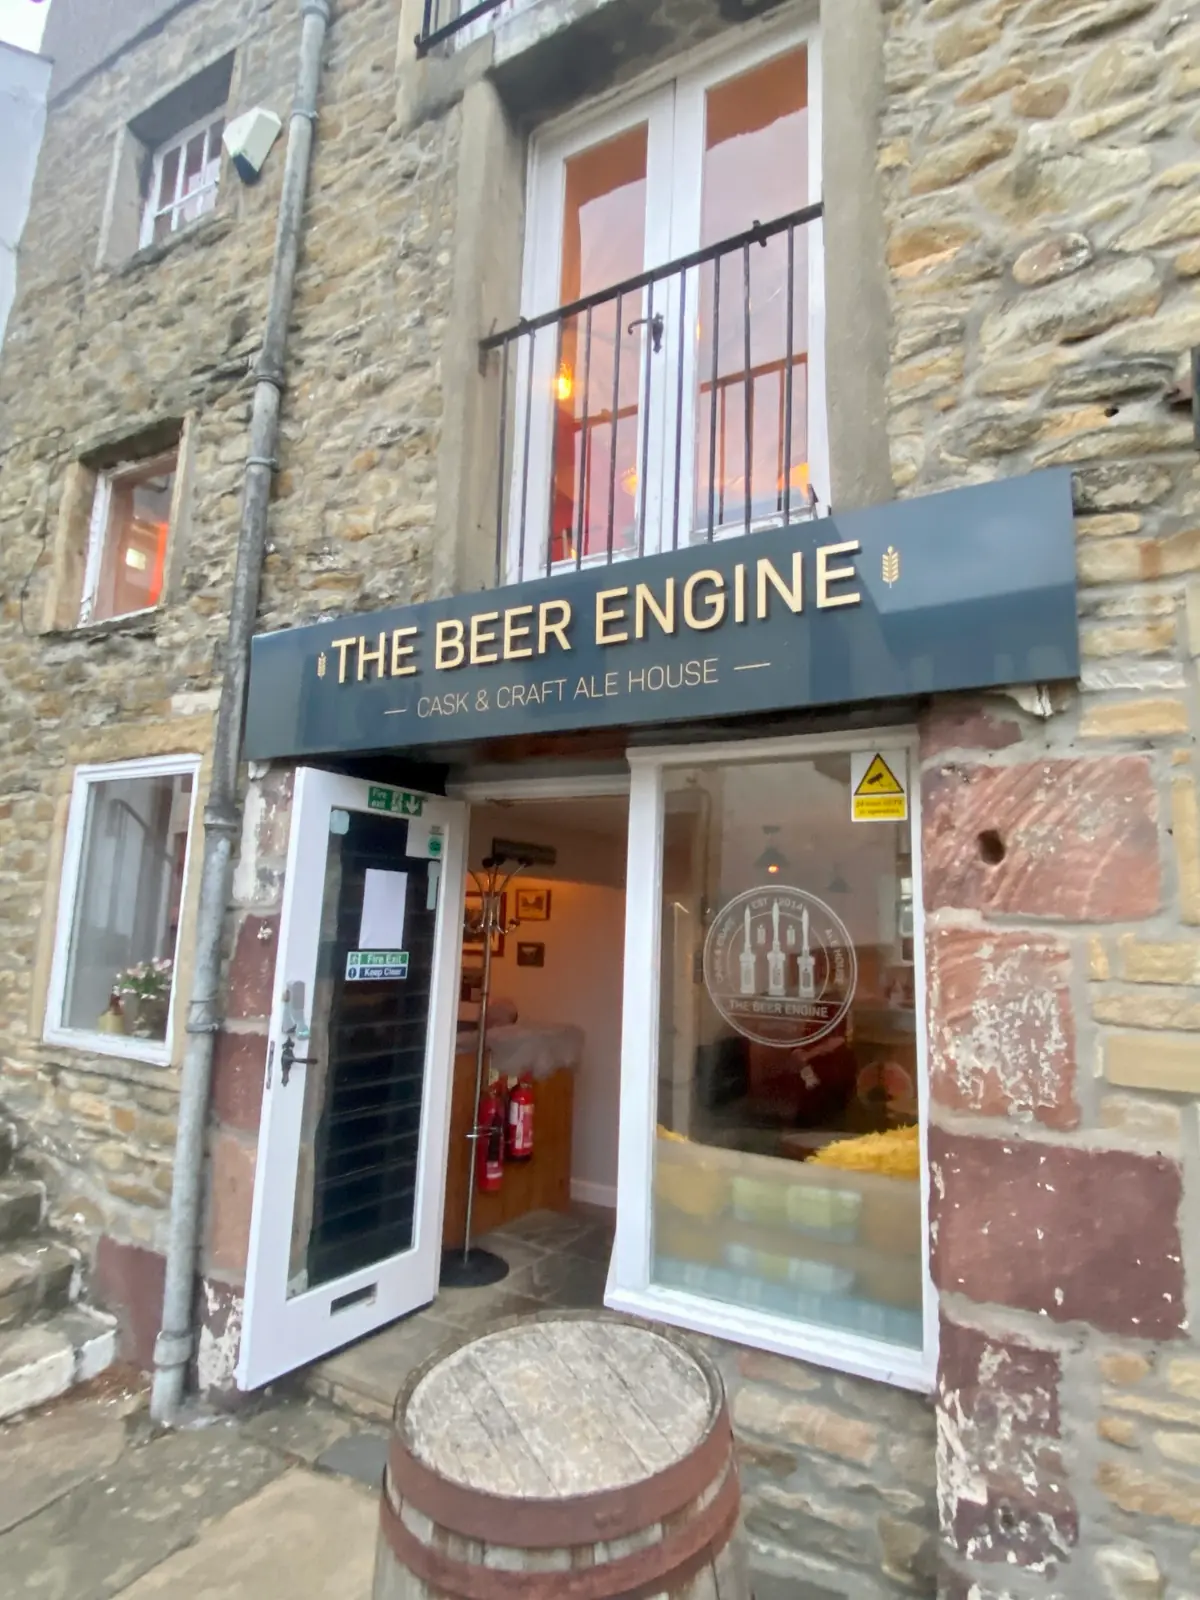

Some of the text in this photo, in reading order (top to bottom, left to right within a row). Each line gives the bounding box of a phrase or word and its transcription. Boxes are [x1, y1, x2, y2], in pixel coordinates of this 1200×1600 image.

[331, 540, 861, 684] THE BEER ENGINE
[417, 657, 719, 718] CASK & CRAFT ALE HOUSE
[730, 1000, 829, 1018] THE BEER ENGINE
